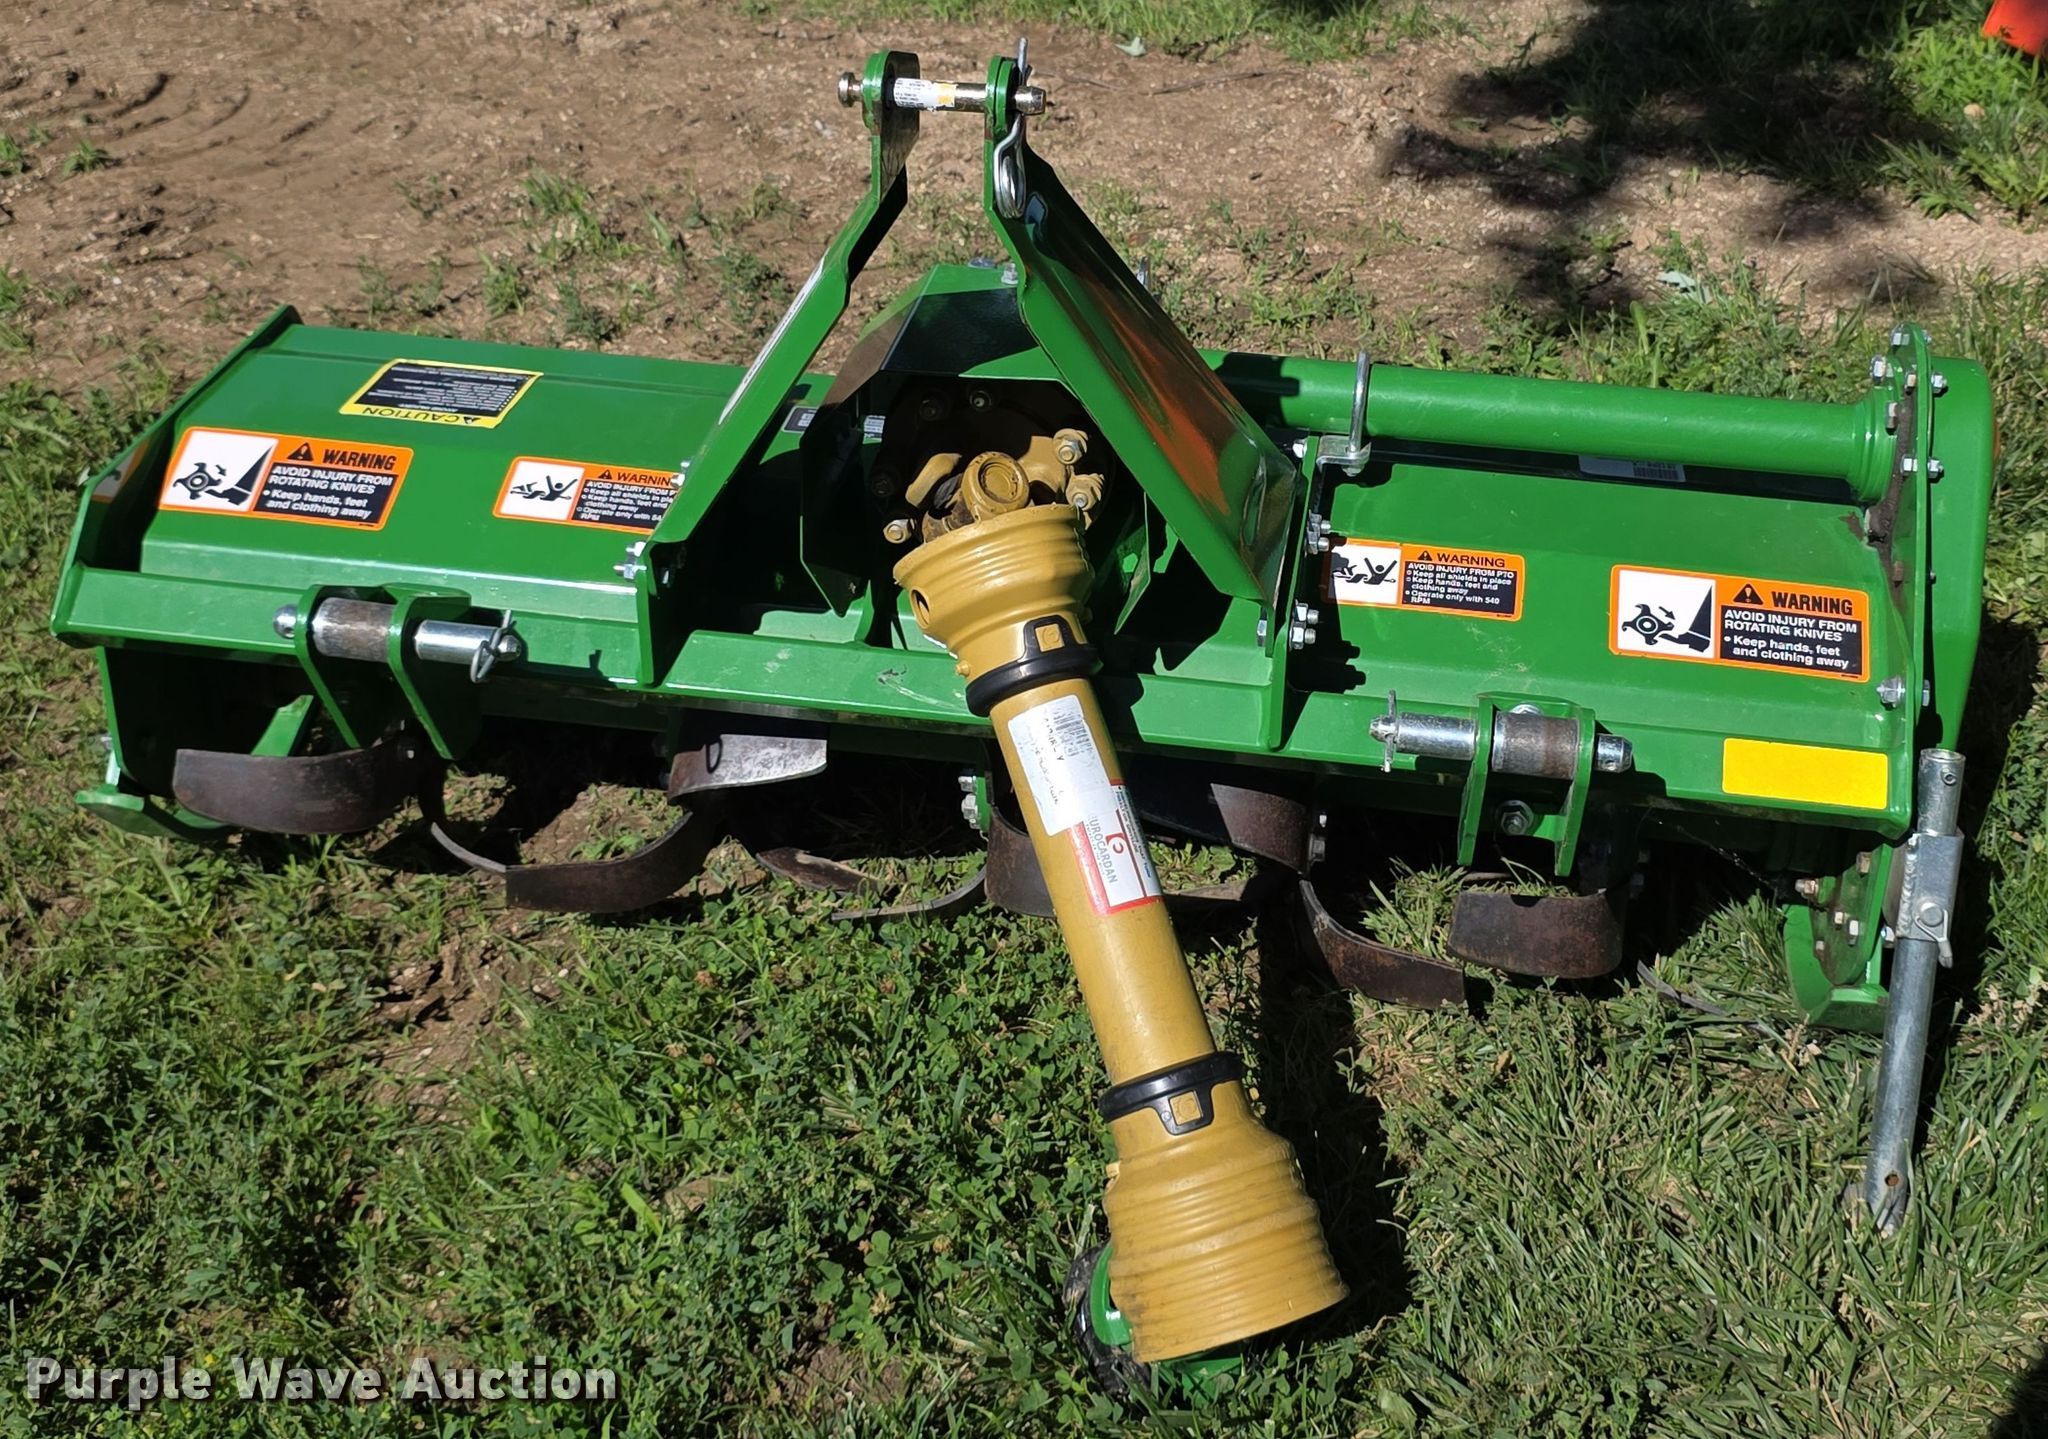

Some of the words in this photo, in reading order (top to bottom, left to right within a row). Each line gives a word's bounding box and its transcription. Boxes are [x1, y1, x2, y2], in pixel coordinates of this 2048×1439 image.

[363, 407, 459, 424] CAUTION
[322, 449, 396, 470] WARNING
[272, 466, 310, 476] AVOID
[312, 470, 356, 482] INJURY
[358, 474, 393, 486] FROM
[617, 472, 672, 486] WARNIN
[269, 475, 328, 489] ROTATING
[330, 482, 376, 494] KNIVES
[587, 481, 612, 489] AVOID
[613, 483, 643, 492] INJURY
[645, 486, 668, 495] FROM
[590, 488, 610, 496] Keep
[272, 490, 302, 501] Keep
[304, 492, 342, 504] hands,
[346, 497, 368, 507] feet
[585, 501, 617, 510] clothing
[588, 494, 607, 502] Keep
[266, 500, 290, 509] and
[292, 501, 339, 516] clothing
[340, 508, 372, 519] away
[1437, 553, 1505, 567] WARNING
[1408, 563, 1434, 571] AVOID
[1436, 565, 1467, 574] INJURY
[1470, 568, 1494, 577] FROM
[1413, 570, 1434, 579] Keep
[1448, 573, 1477, 582] shields
[1490, 577, 1512, 585] place
[1411, 584, 1445, 593] clothing
[1412, 577, 1433, 585] Keep
[1482, 582, 1498, 590] and
[1411, 590, 1444, 599] Operate
[1446, 594, 1464, 602] only
[1465, 595, 1483, 603] with
[1411, 596, 1430, 604] RPM
[1772, 591, 1852, 615] WARNING
[1724, 609, 1765, 622] AVOID
[1768, 613, 1817, 628] INJURY
[1818, 620, 1857, 633] FROM
[1725, 620, 1791, 635] ROTATING
[1794, 628, 1842, 641] KNIVES
[1734, 635, 1766, 649] Keep
[1770, 639, 1814, 654] hands,
[1816, 645, 1840, 656] feet
[1733, 646, 1757, 657] and
[1761, 650, 1813, 665] clothing
[1816, 656, 1849, 670] away
